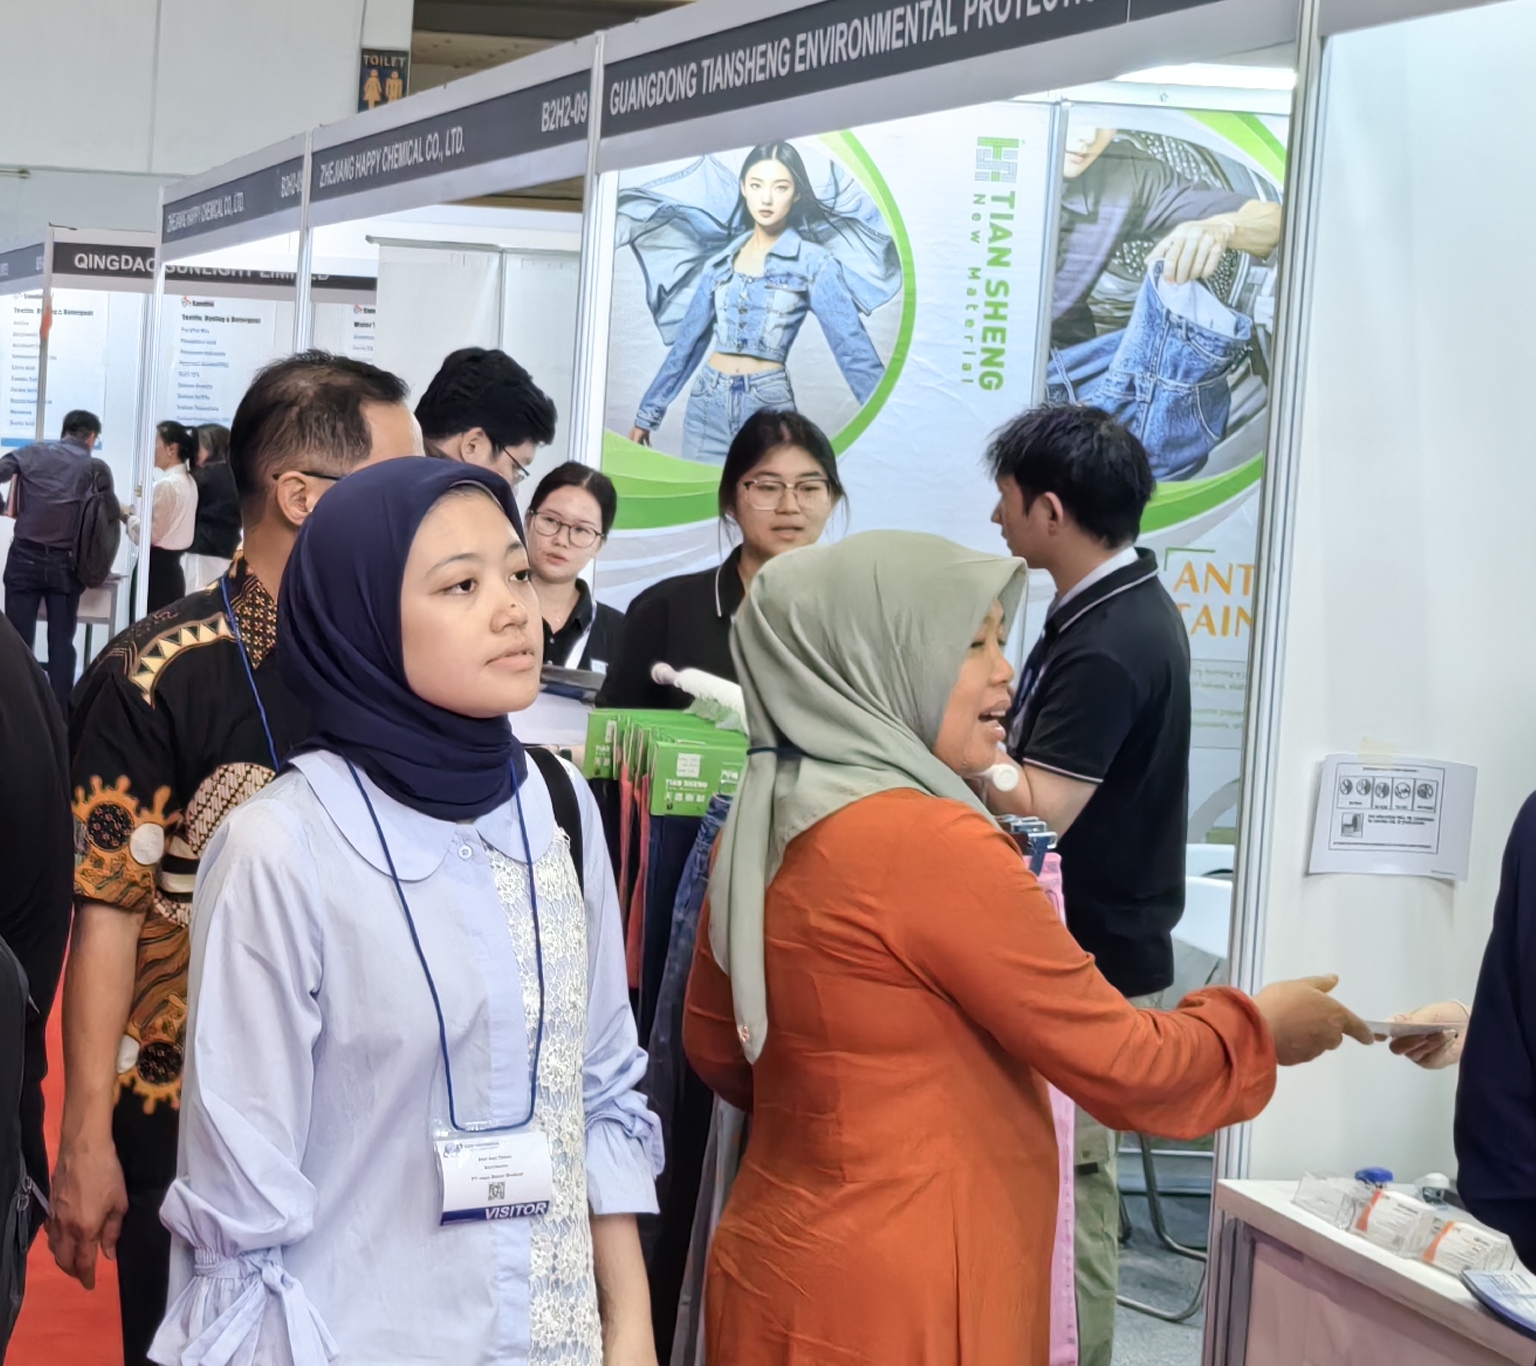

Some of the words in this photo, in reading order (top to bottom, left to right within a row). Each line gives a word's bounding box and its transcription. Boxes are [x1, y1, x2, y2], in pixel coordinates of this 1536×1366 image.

[364, 55, 406, 68] TOILET
[609, 61, 697, 116] GUANGDONG
[701, 37, 790, 95] TIANSHENG
[542, 91, 588, 132] B2H2-09
[355, 148, 382, 179] HAPPY
[382, 136, 424, 173] CHEMICAL
[445, 125, 465, 155] LTD.
[970, 193, 986, 244] New
[986, 190, 1016, 268] TIAN
[961, 266, 982, 385] Material
[978, 279, 1010, 392] SHENG
[485, 1202, 547, 1221] VISITOR
